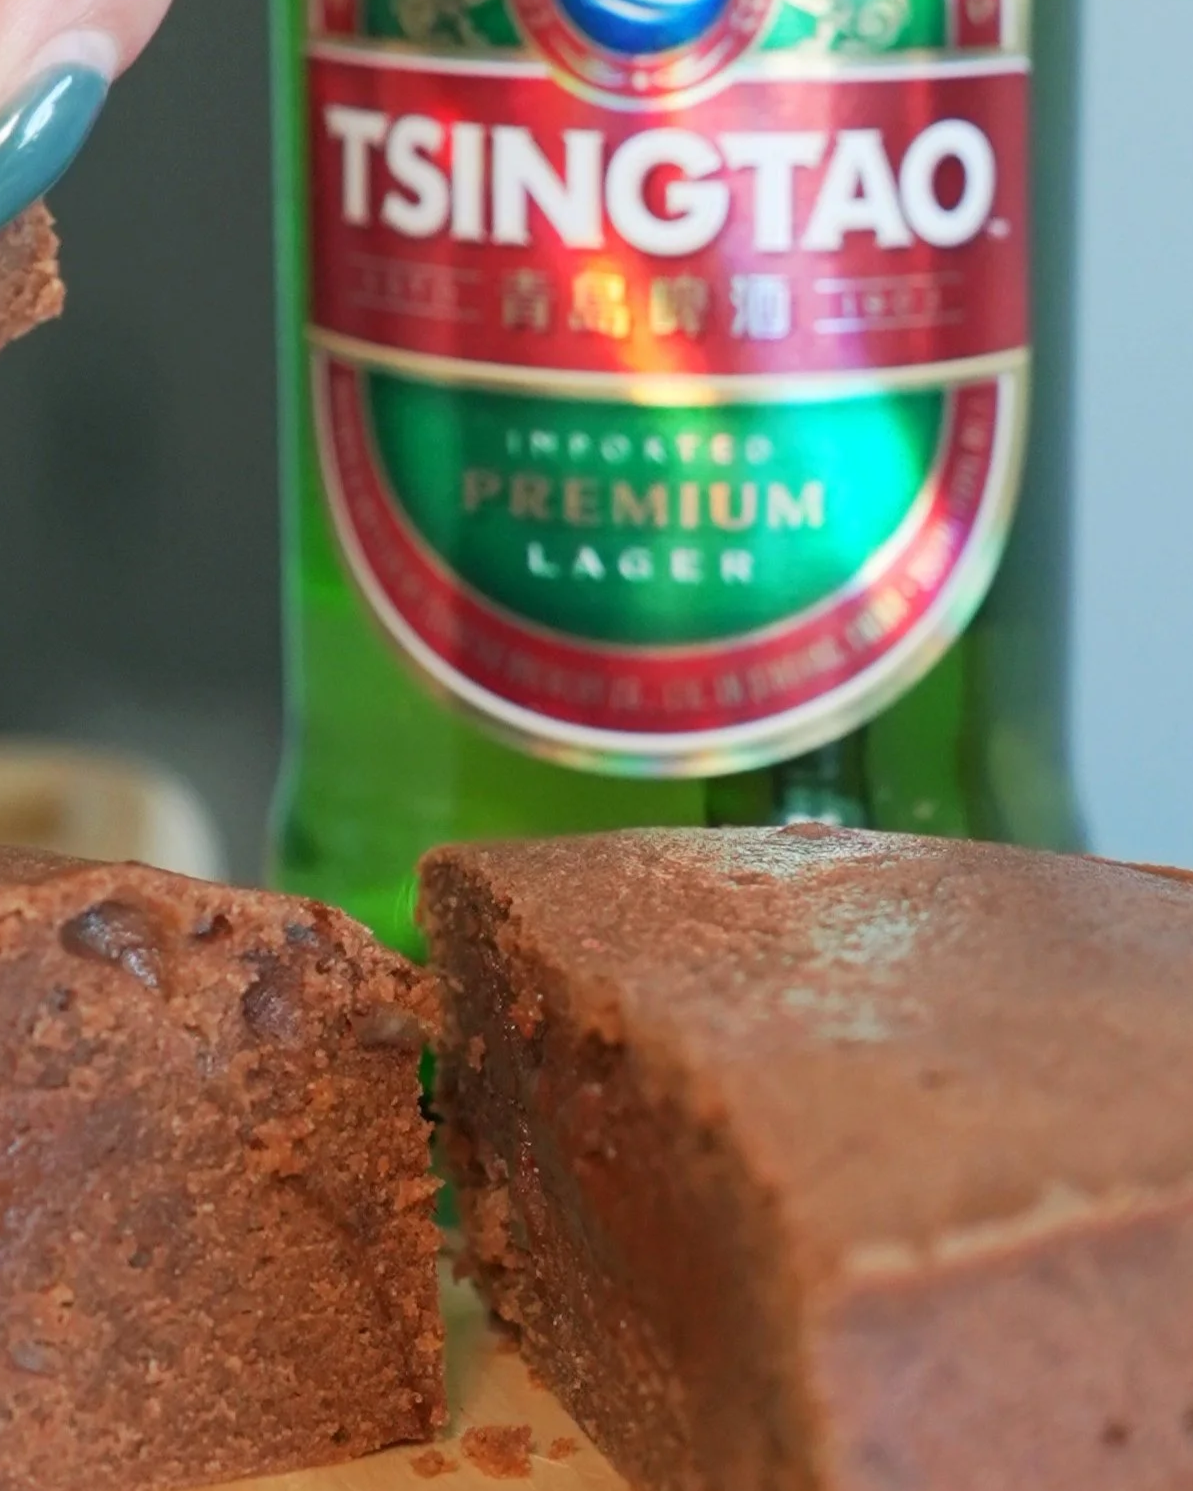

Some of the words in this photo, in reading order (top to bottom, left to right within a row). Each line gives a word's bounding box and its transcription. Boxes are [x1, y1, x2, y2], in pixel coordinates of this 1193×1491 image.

[324, 104, 995, 257] TSINGTAO
[463, 467, 825, 532] PREMIUM
[526, 540, 755, 584] LAGER
